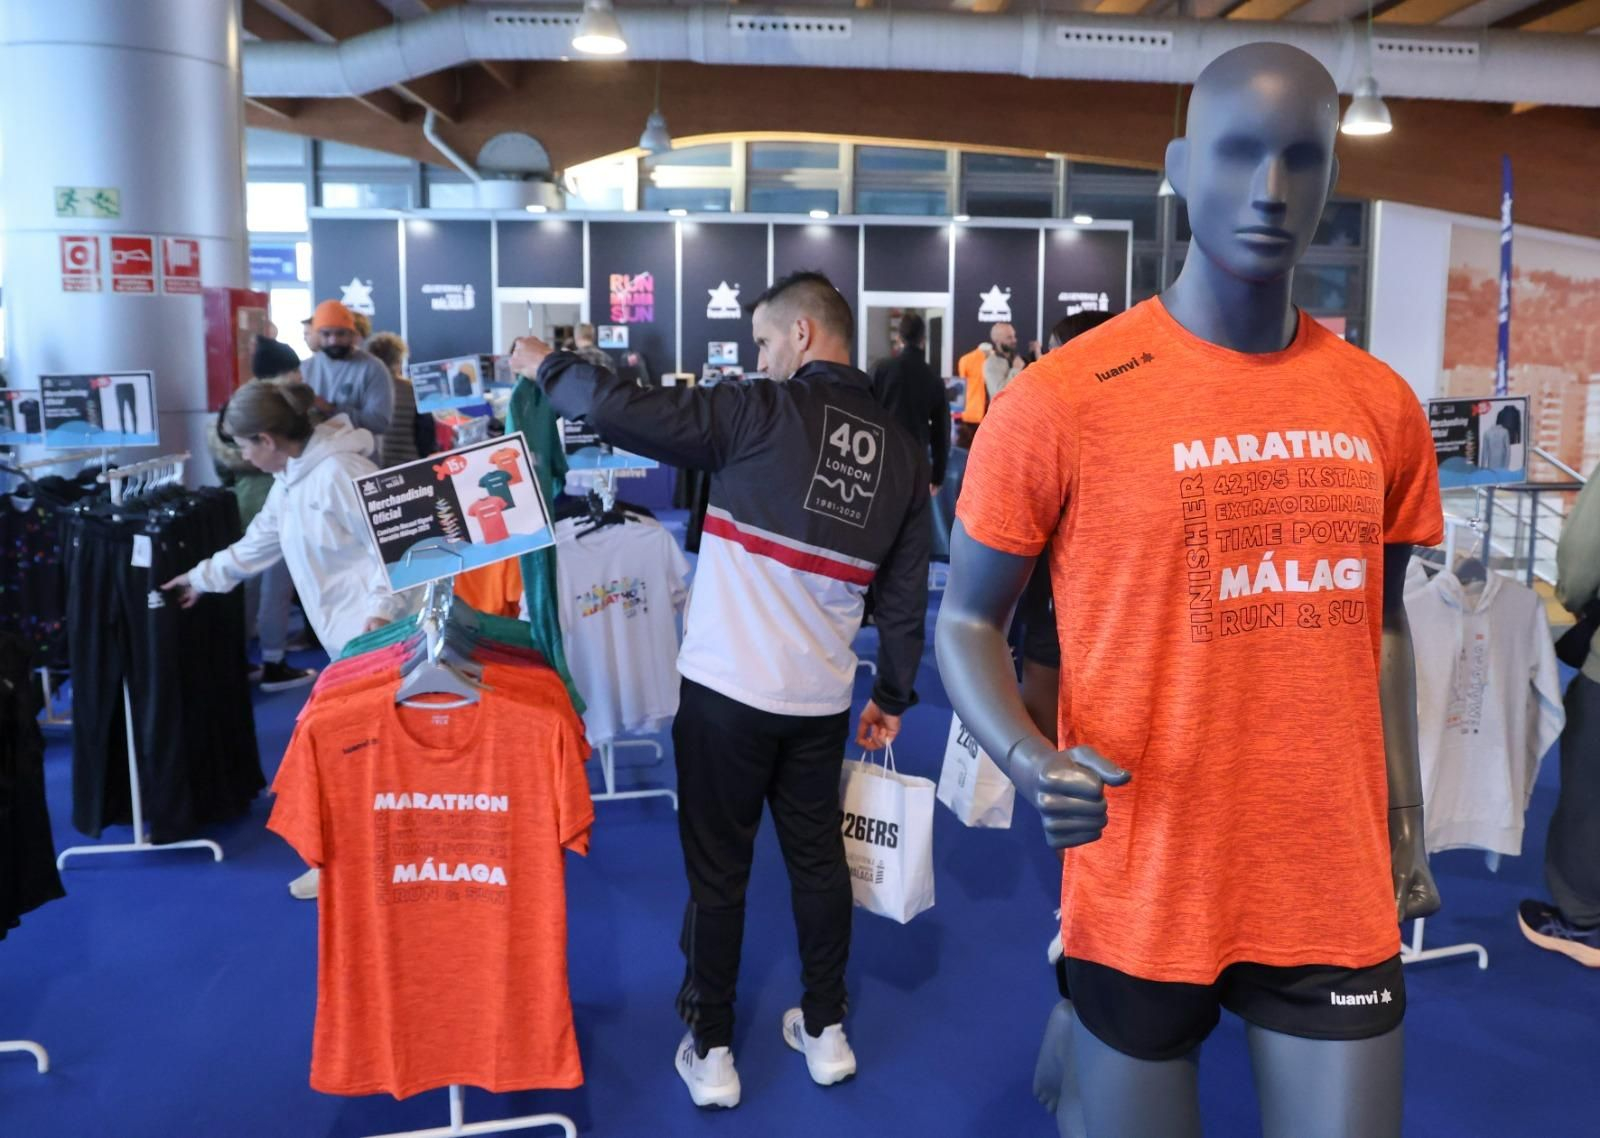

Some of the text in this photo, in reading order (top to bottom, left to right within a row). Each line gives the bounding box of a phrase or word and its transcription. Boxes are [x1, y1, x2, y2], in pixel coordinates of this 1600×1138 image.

[610, 273, 654, 291] RUN
[610, 305, 654, 322] SUN
[1095, 357, 1140, 383] luanvi
[829, 422, 877, 465] 40
[1173, 430, 1374, 472] MARATHON
[825, 457, 872, 482] LONDON
[1213, 469, 1290, 496] 42,195
[1299, 467, 1317, 487] K
[368, 485, 434, 513] Merchandising
[372, 506, 402, 525] Oficial
[1216, 520, 1381, 553] TIME POWER
[1179, 474, 1213, 643] FINISHER
[1219, 550, 1367, 601] MÁLAG
[1220, 600, 1367, 637] RUN & SU
[373, 792, 509, 812] MARATHON
[392, 856, 508, 886] MÁLAGA
[1330, 990, 1379, 1006] luanvi
